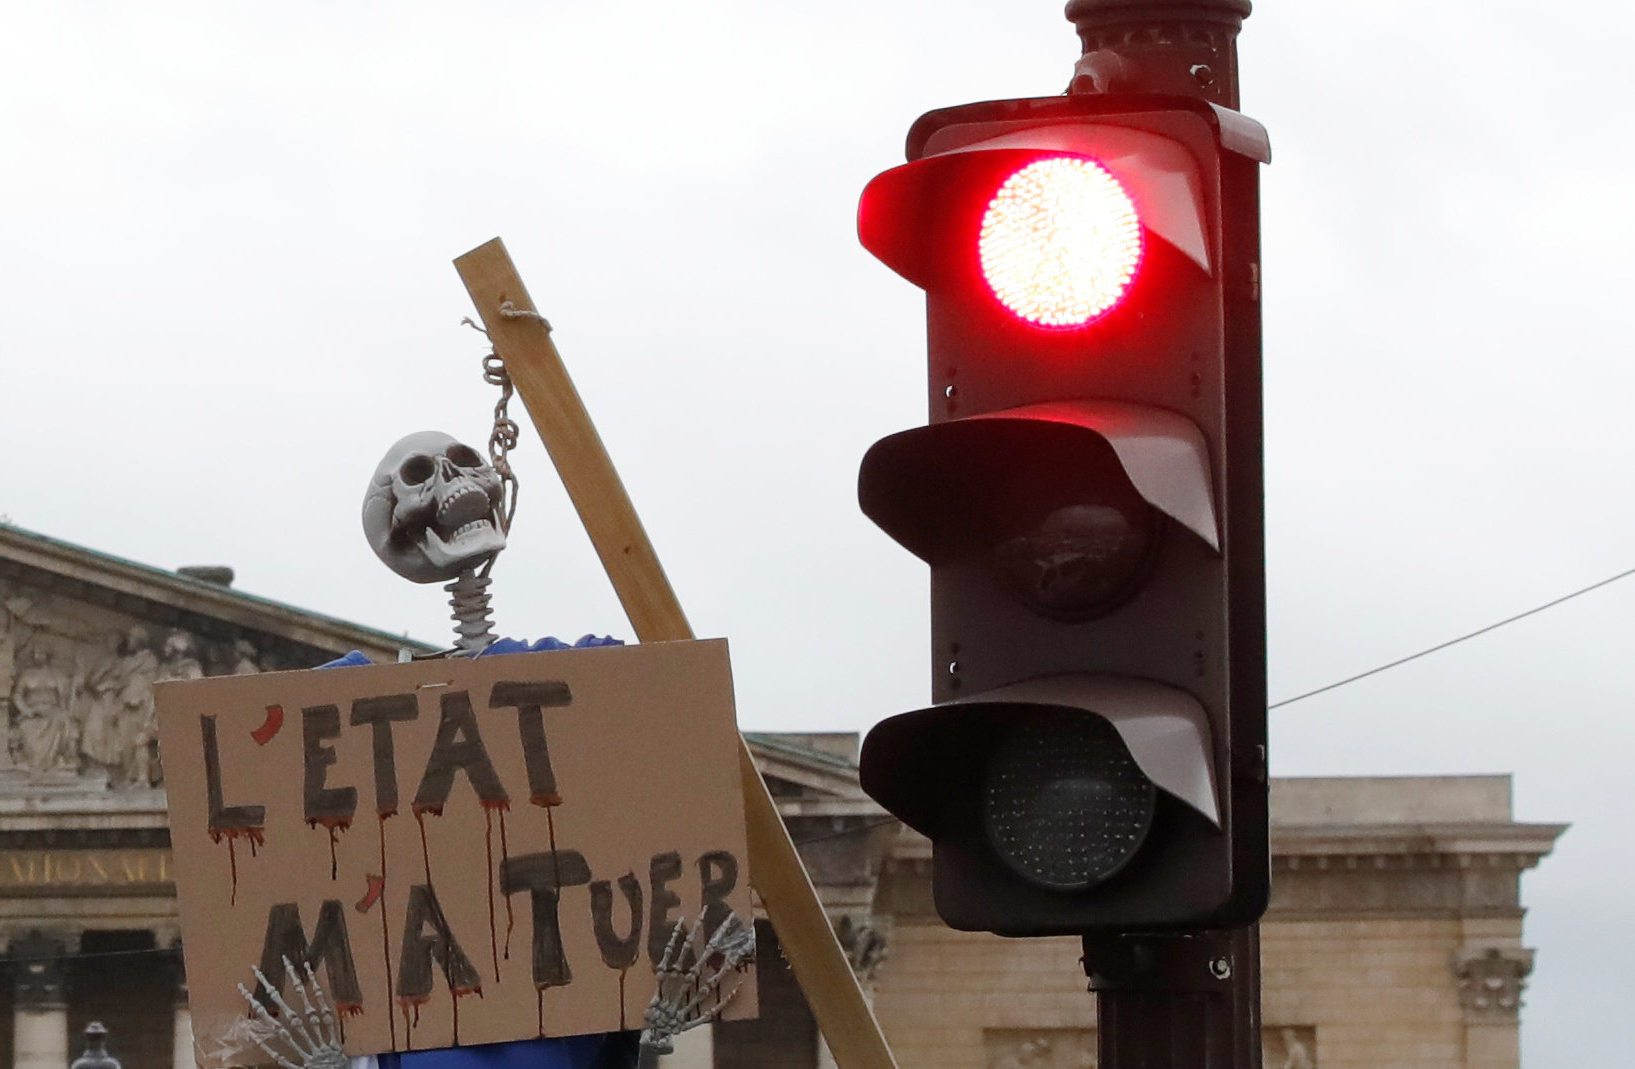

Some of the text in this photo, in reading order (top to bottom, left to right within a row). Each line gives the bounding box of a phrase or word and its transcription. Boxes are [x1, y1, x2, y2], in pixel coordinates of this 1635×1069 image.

[201, 681, 572, 838] L'ETAT
[250, 848, 739, 1008] M'A TUER
